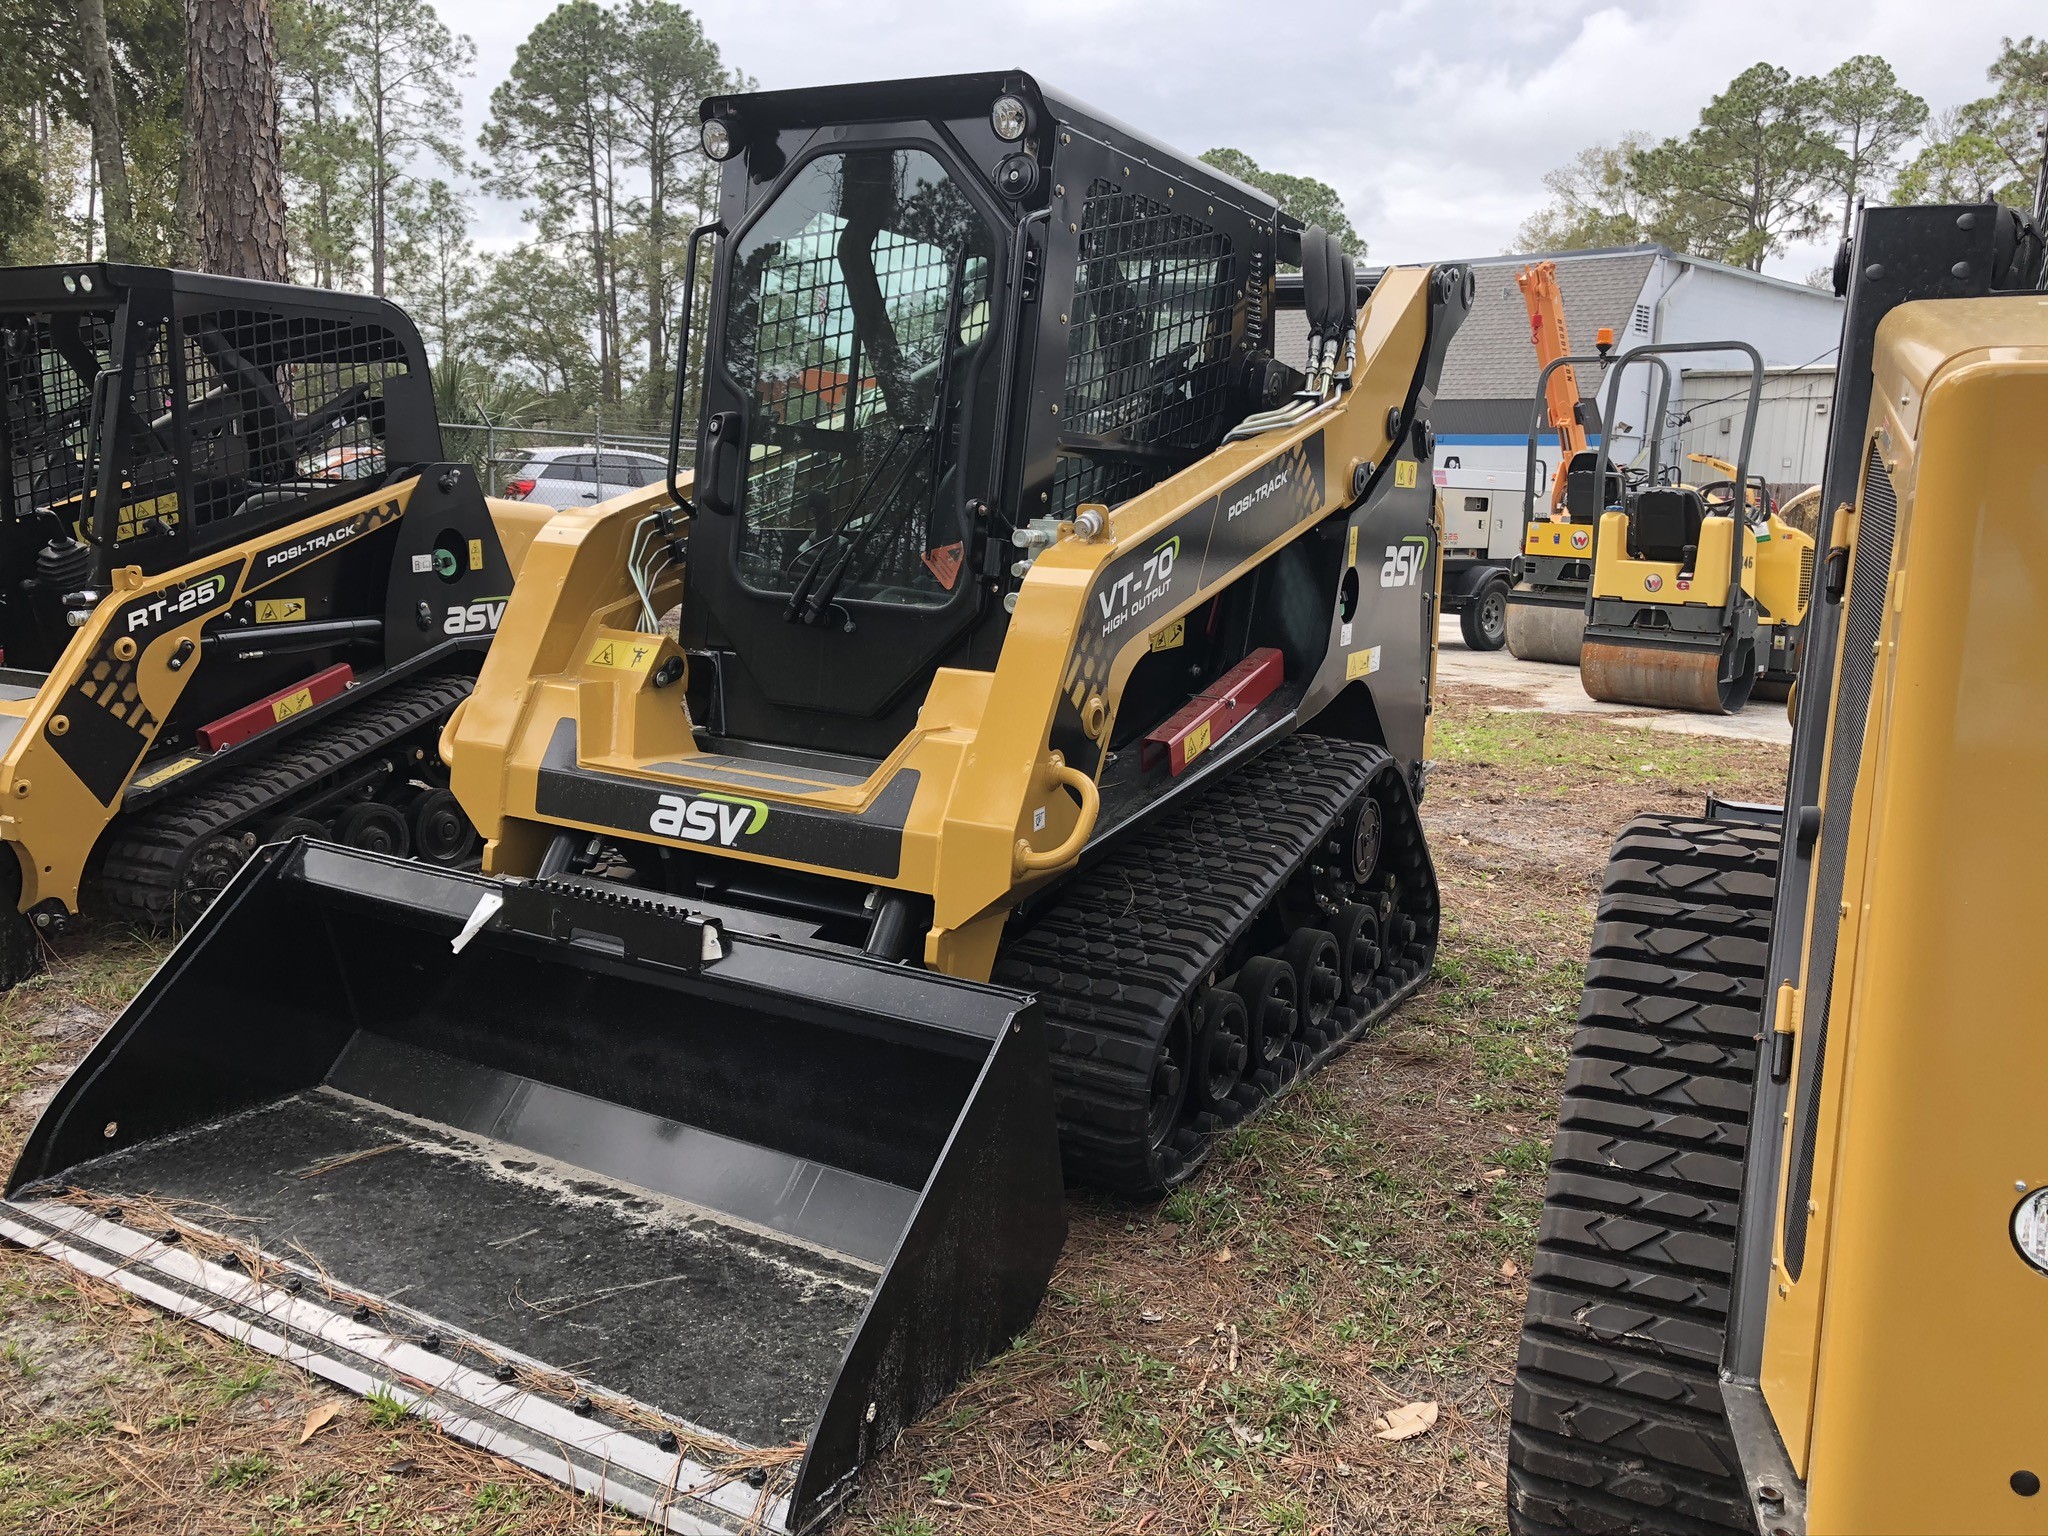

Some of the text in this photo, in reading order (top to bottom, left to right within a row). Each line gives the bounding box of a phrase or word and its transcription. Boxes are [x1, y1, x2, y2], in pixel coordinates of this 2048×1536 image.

[1228, 469, 1288, 521] POSI-TRACK
[266, 524, 356, 568] POSI-TRACK
[127, 581, 216, 632] RT-25
[1098, 545, 1174, 620] VT-70
[1102, 577, 1172, 638] HIGH OUTPUT
[649, 793, 752, 846] asv
